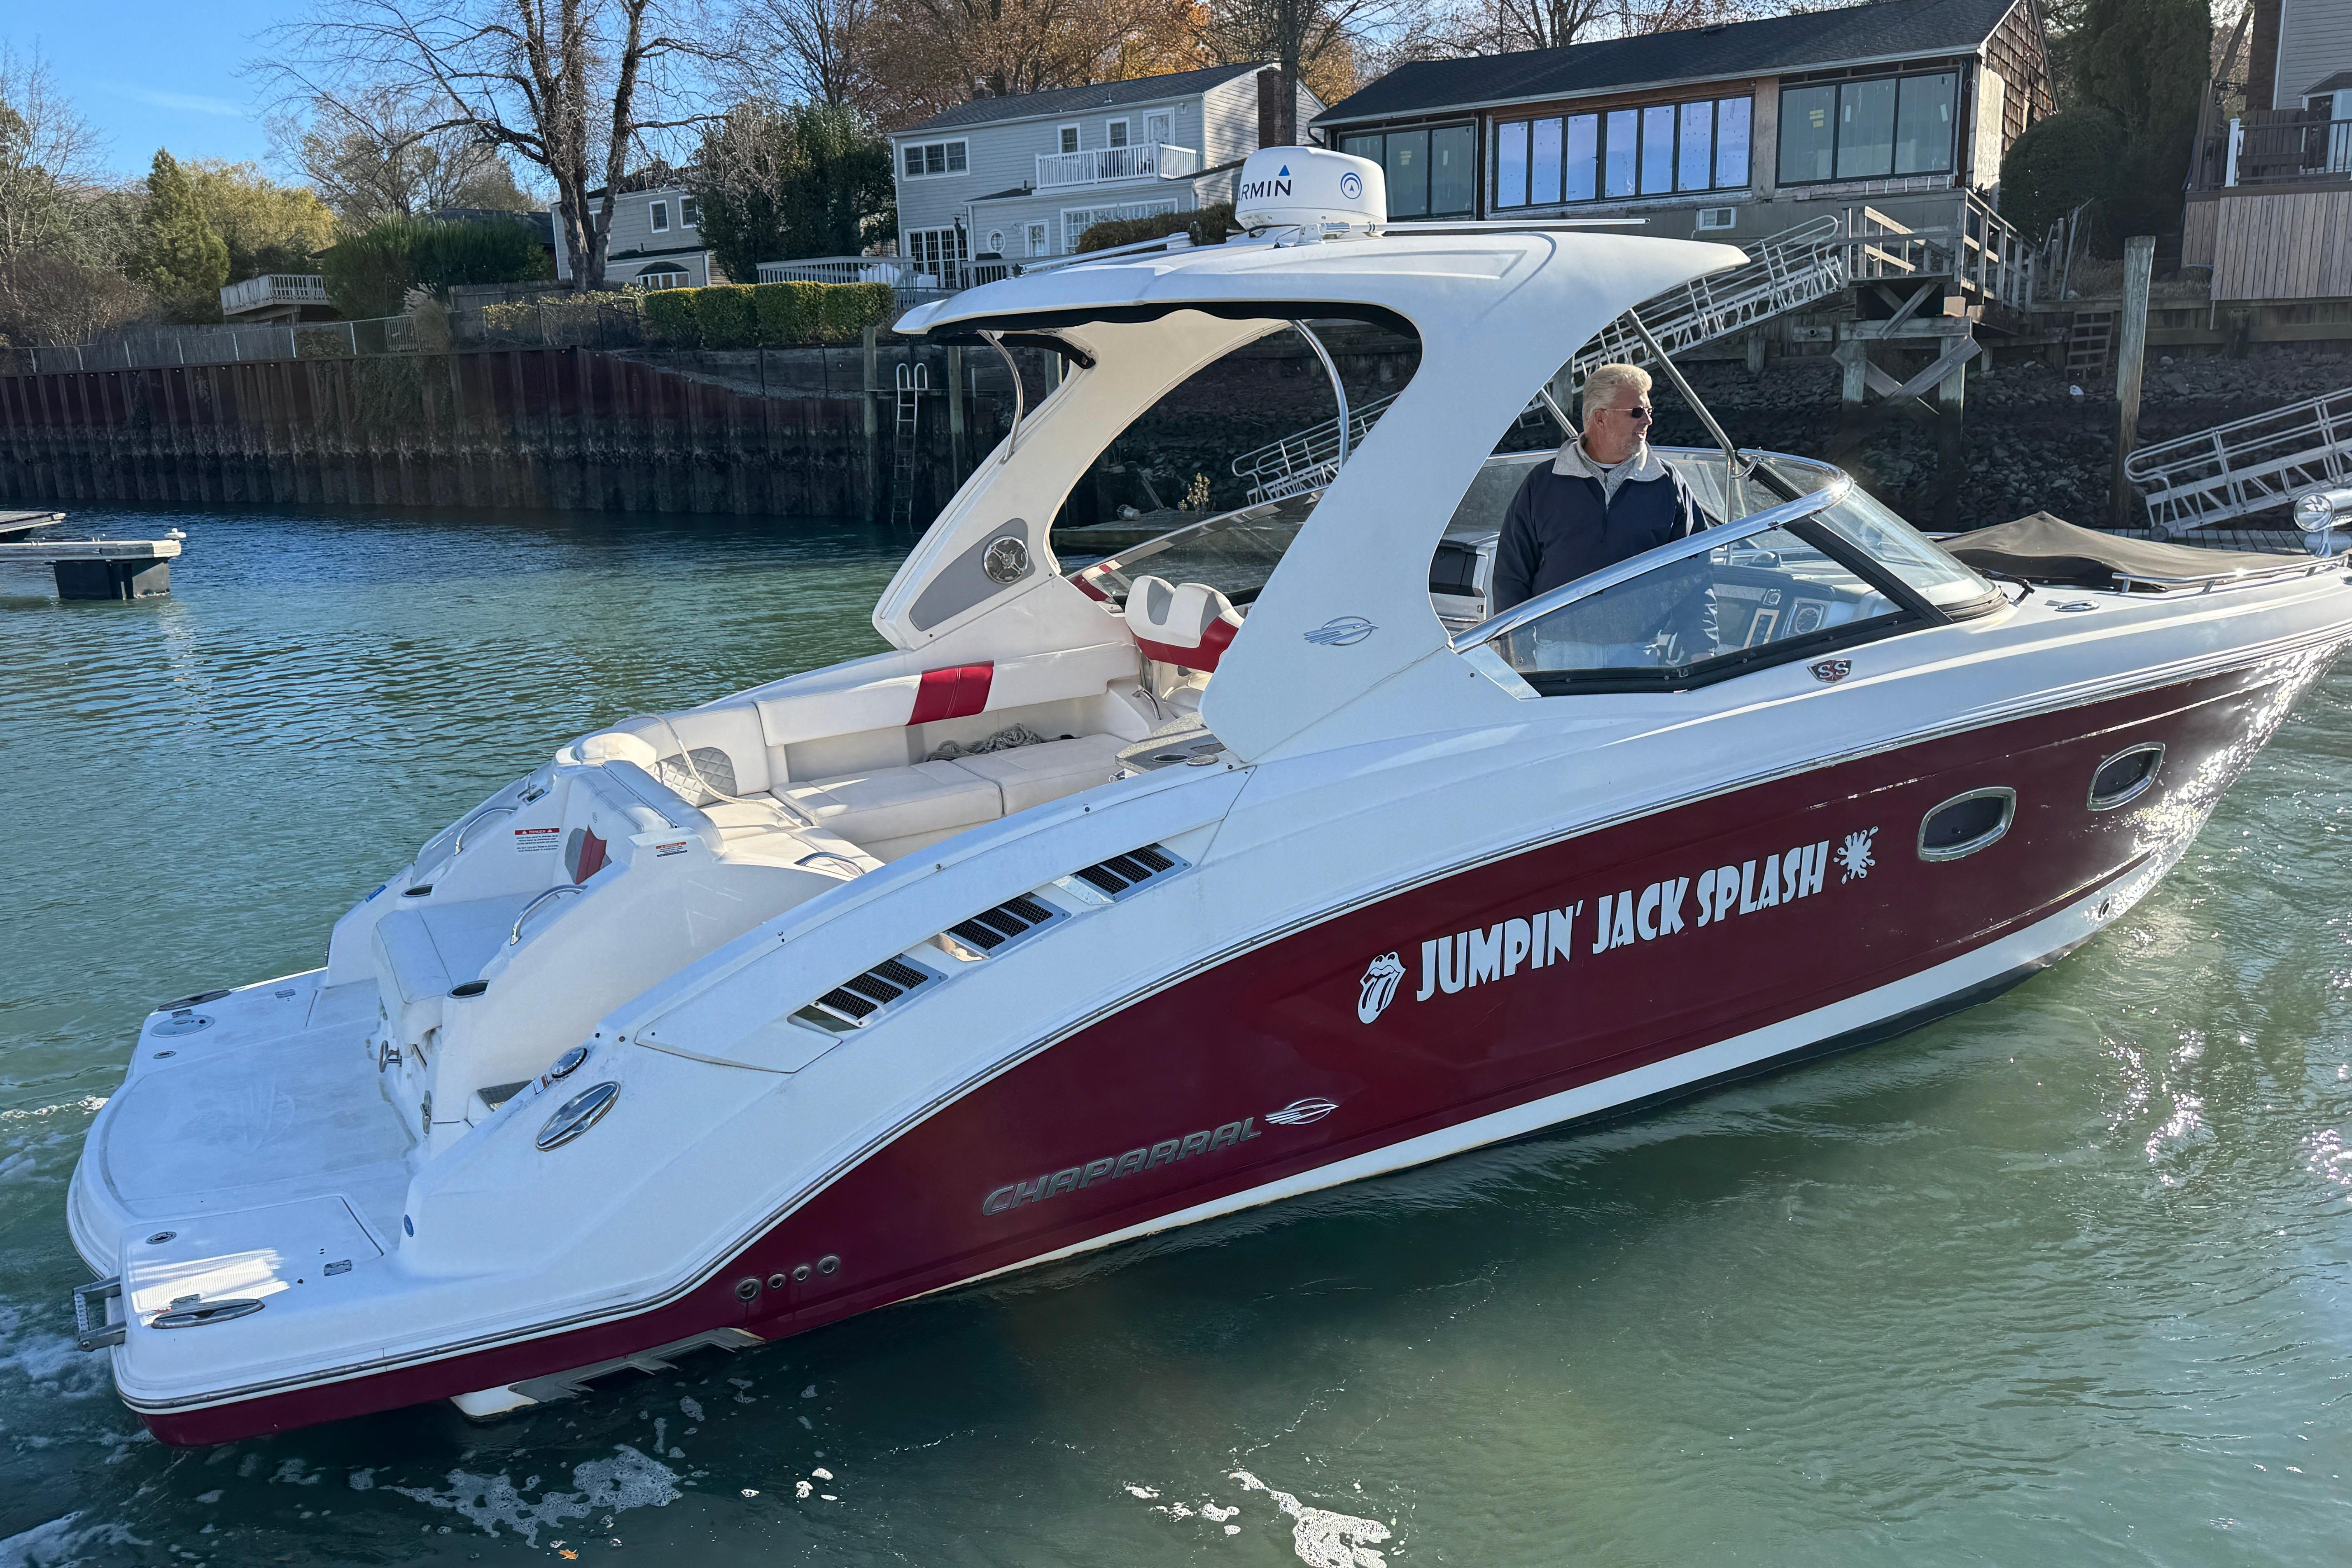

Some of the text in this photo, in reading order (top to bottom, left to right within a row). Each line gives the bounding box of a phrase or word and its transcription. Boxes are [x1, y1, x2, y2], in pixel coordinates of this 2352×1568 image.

[1817, 662, 1849, 678] SS
[1416, 840, 1829, 1002] JUMPIN' JACK SPLASH
[982, 1117, 1262, 1216] CHAPARRAL
